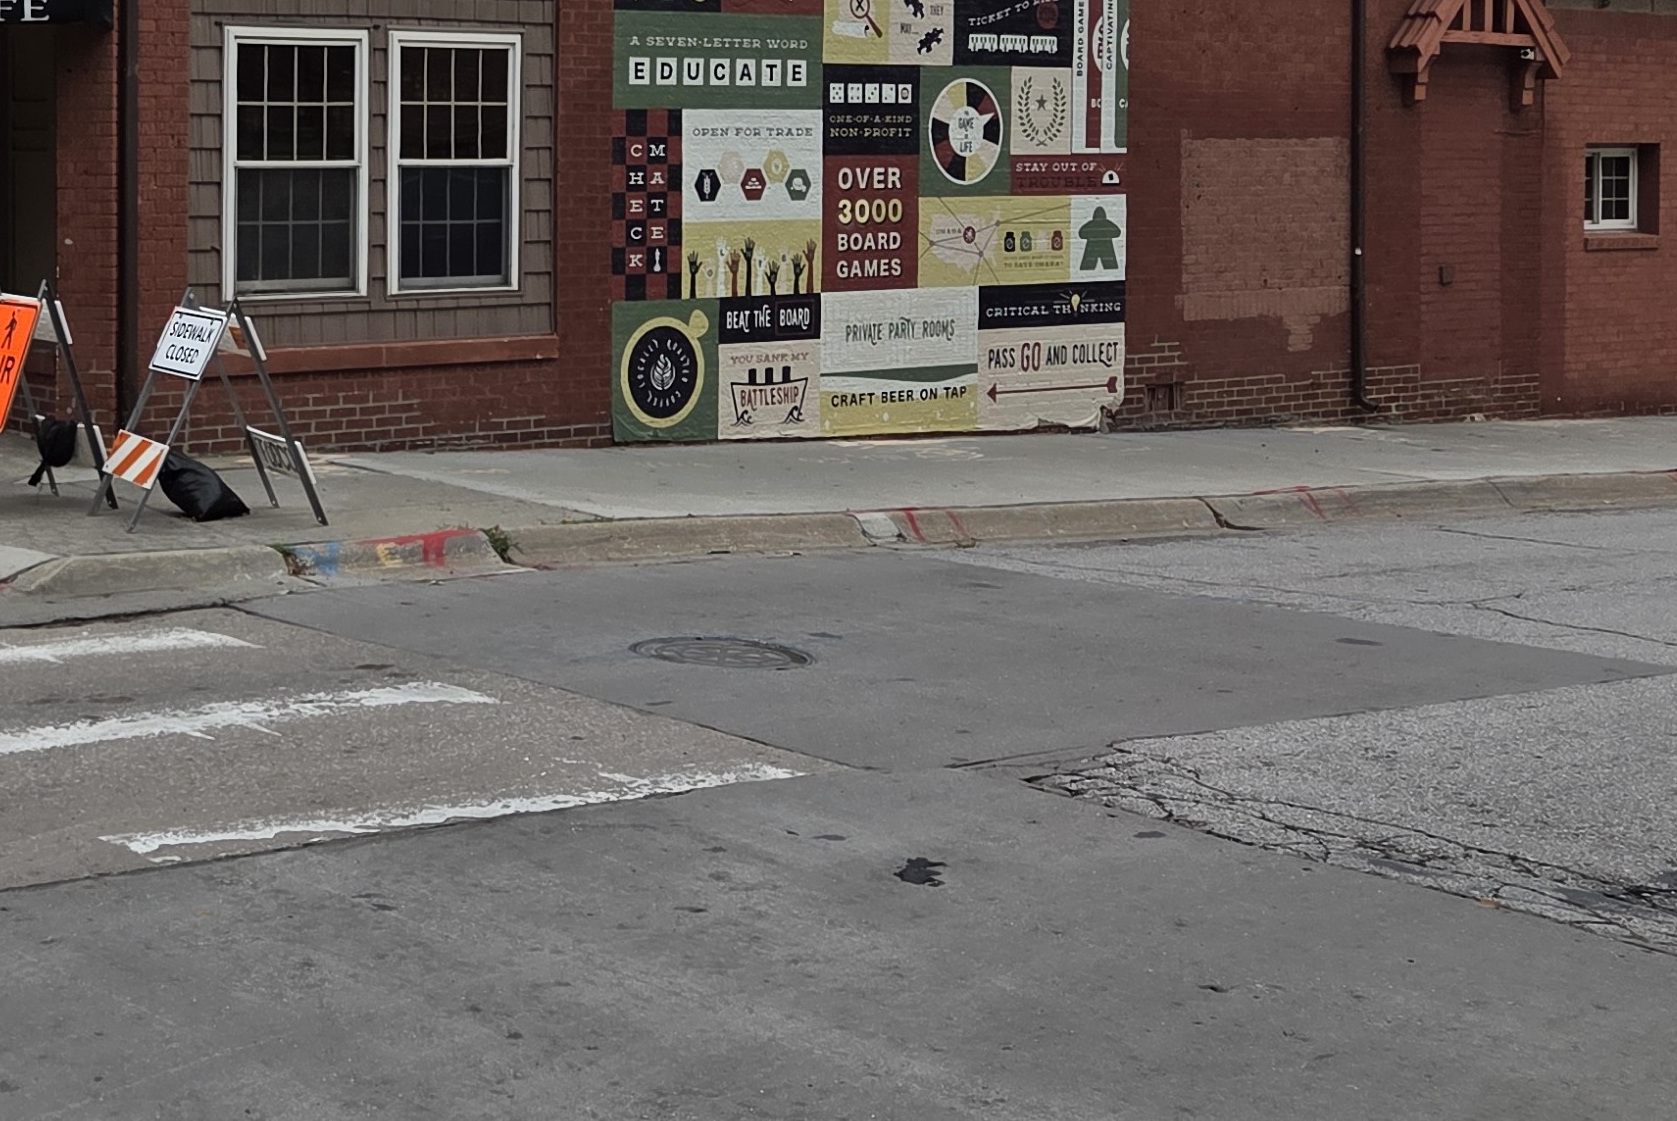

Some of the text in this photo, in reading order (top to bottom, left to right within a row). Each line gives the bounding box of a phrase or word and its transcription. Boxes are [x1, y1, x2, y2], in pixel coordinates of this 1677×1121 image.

[929, 4, 944, 16] THEY
[968, 7, 1012, 27] TICKET
[1014, 0, 1030, 13] TO
[629, 36, 640, 47] A
[766, 39, 809, 50] WORD
[1076, 37, 1085, 77] BOARD
[631, 60, 804, 83] EDUCATE
[692, 127, 813, 137] OPEN FOR TRADE
[829, 127, 912, 138] NON-PROFIT
[958, 117, 975, 131] GAME
[959, 141, 973, 153] LIFE
[1015, 162, 1098, 172] STAY OUT OF
[838, 166, 902, 190] OVER
[1017, 176, 1098, 189] TROUBLE
[837, 198, 903, 224] 3000
[837, 232, 902, 252] BOARD
[836, 258, 902, 278] GAMES
[726, 304, 811, 333] BEAT THE BOARD
[986, 305, 1049, 317] CRITICAL
[170, 321, 214, 343] SIDEWALK
[845, 316, 955, 345] PRIVATE PARTY ROOMS
[166, 344, 199, 363] CLOSED
[730, 352, 809, 365] YOU SANK MY
[988, 342, 1119, 372] PASS GO AND COLLECT
[740, 386, 799, 411] BATTLESHIP
[831, 385, 967, 408] CRAFT BEER ON TAP
